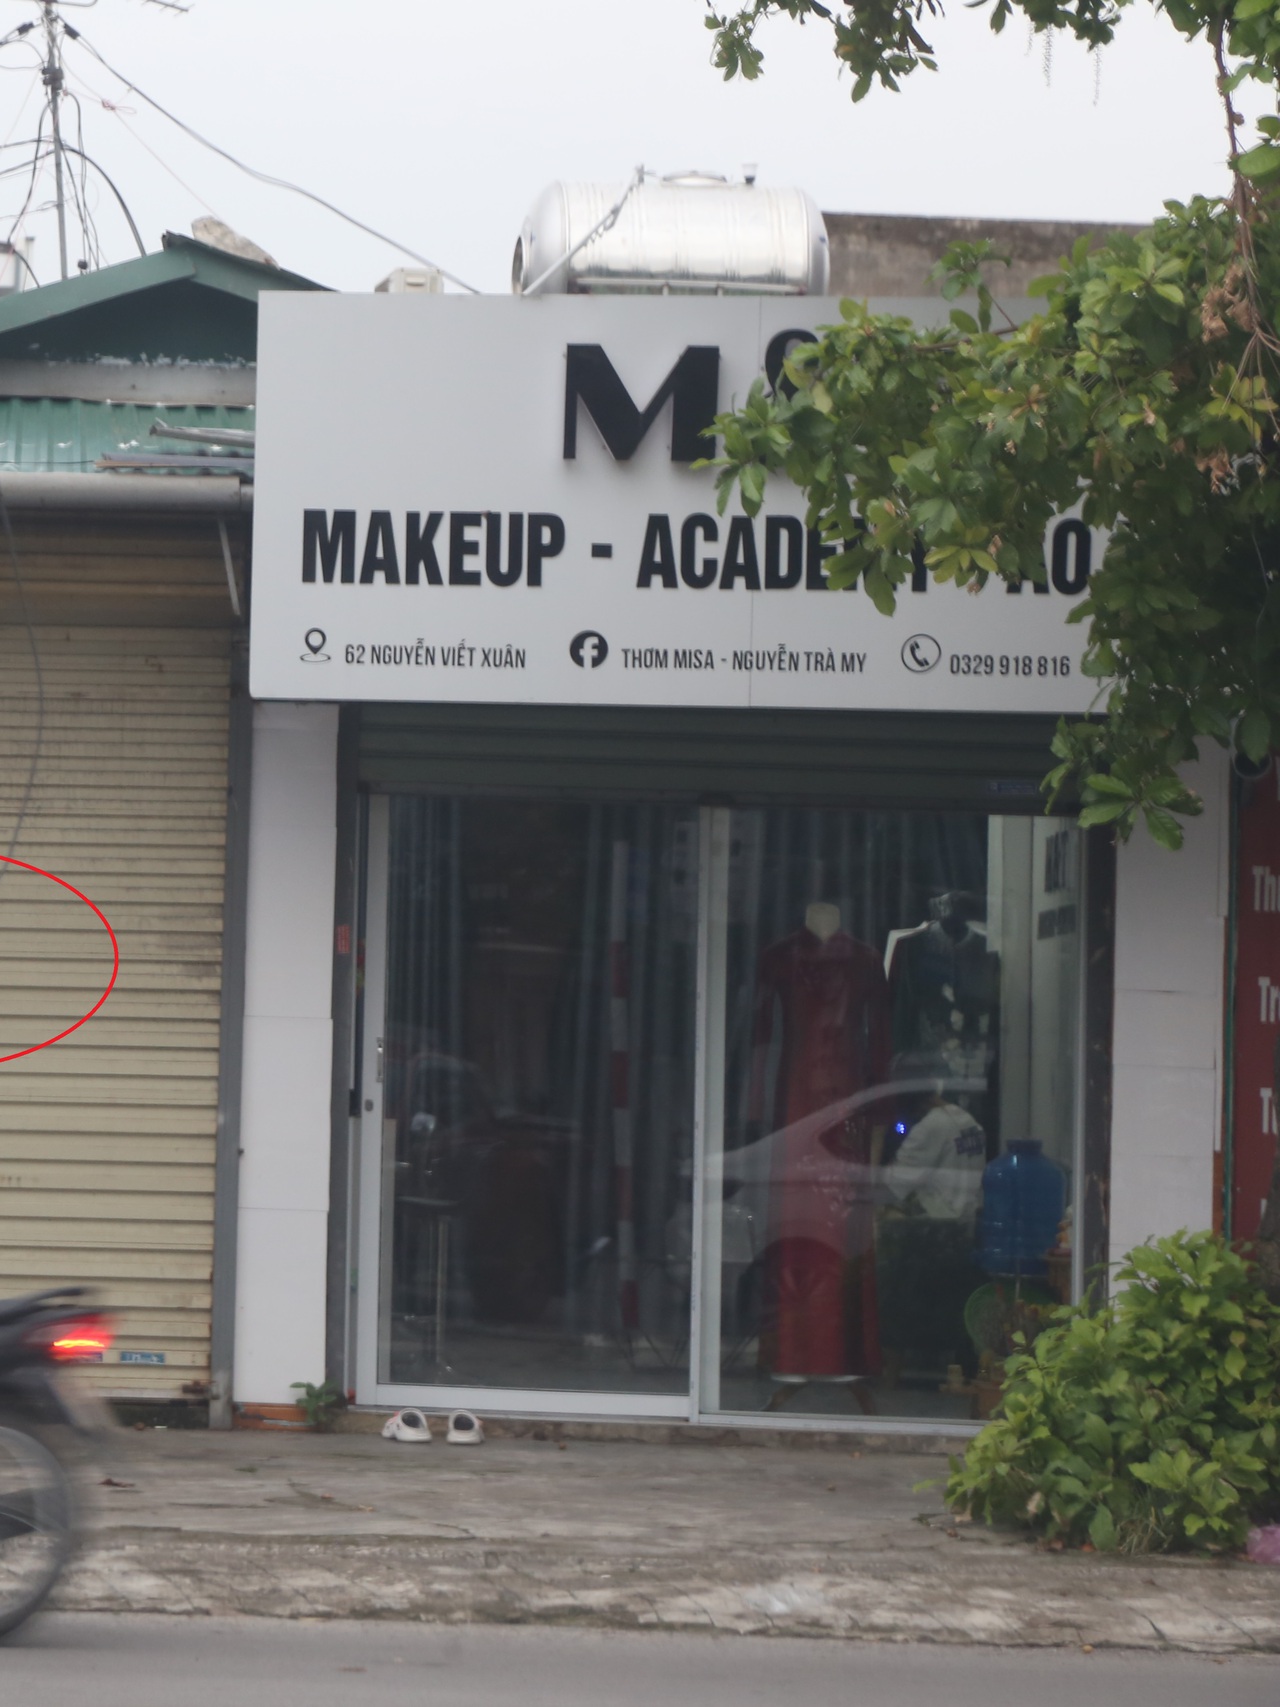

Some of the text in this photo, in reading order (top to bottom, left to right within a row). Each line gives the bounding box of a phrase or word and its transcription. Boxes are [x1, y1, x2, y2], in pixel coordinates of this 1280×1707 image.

[301, 508, 566, 588] MAKEUP
[345, 638, 526, 669] 62 NGUYỄN VIẾT XUÂN
[620, 647, 669, 670] THƠM
[673, 649, 715, 671] MISA
[732, 643, 800, 673] NGUYỄN
[803, 647, 837, 673] TRÀ
[841, 652, 868, 674] MY
[950, 653, 1071, 677] 0329 918 816
